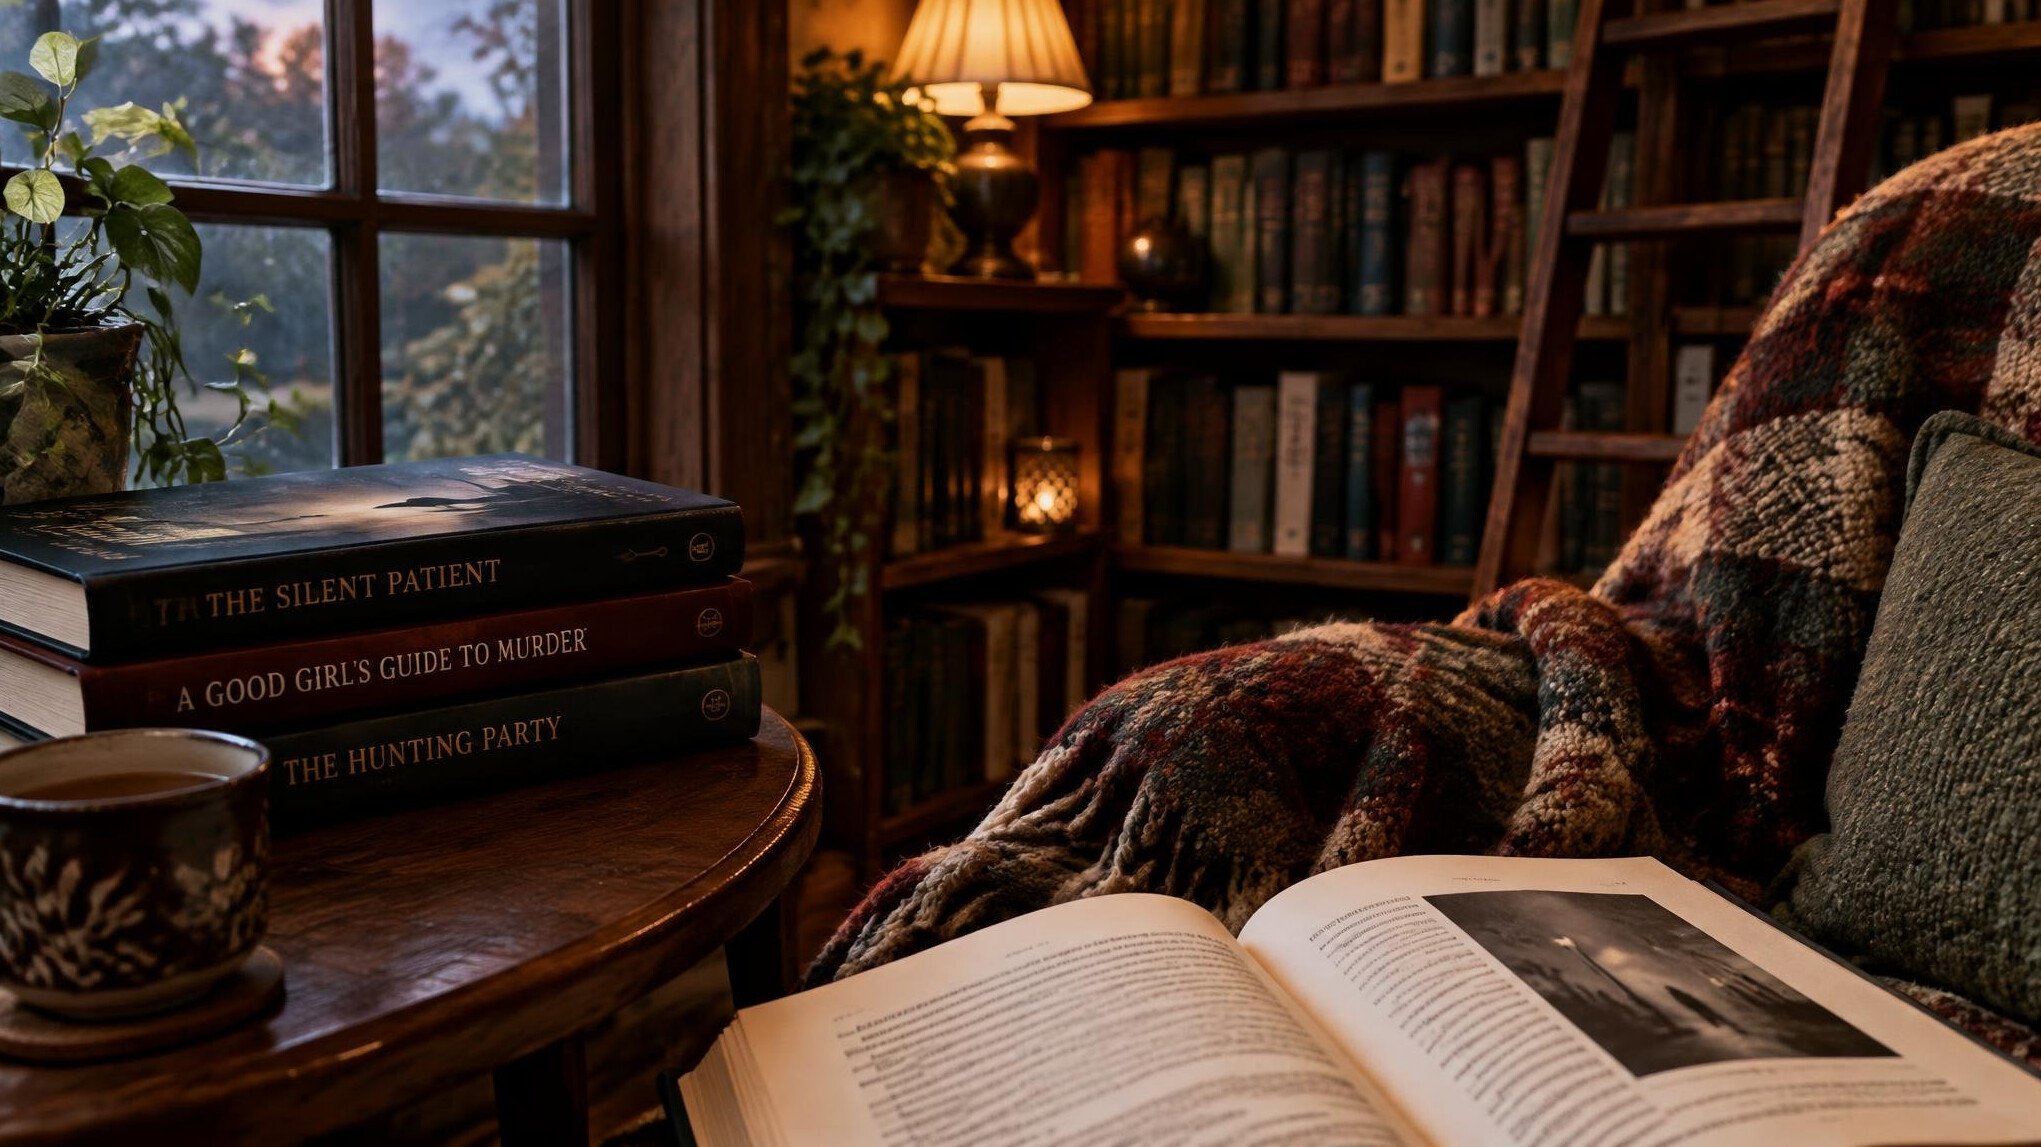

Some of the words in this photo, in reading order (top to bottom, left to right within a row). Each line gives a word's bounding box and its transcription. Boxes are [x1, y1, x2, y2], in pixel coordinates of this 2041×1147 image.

[206, 587, 265, 617] THE
[276, 574, 377, 609] SILENT
[388, 559, 500, 596] PATIENT
[177, 686, 196, 712] A
[205, 672, 286, 707] GOOD
[295, 659, 371, 692] GIRL'S
[379, 648, 452, 680] GUIDE
[459, 642, 490, 668] TO
[498, 628, 588, 662] MURDER
[283, 753, 339, 786] THE
[349, 731, 473, 775] HUNTING
[482, 716, 562, 751] PARTY
